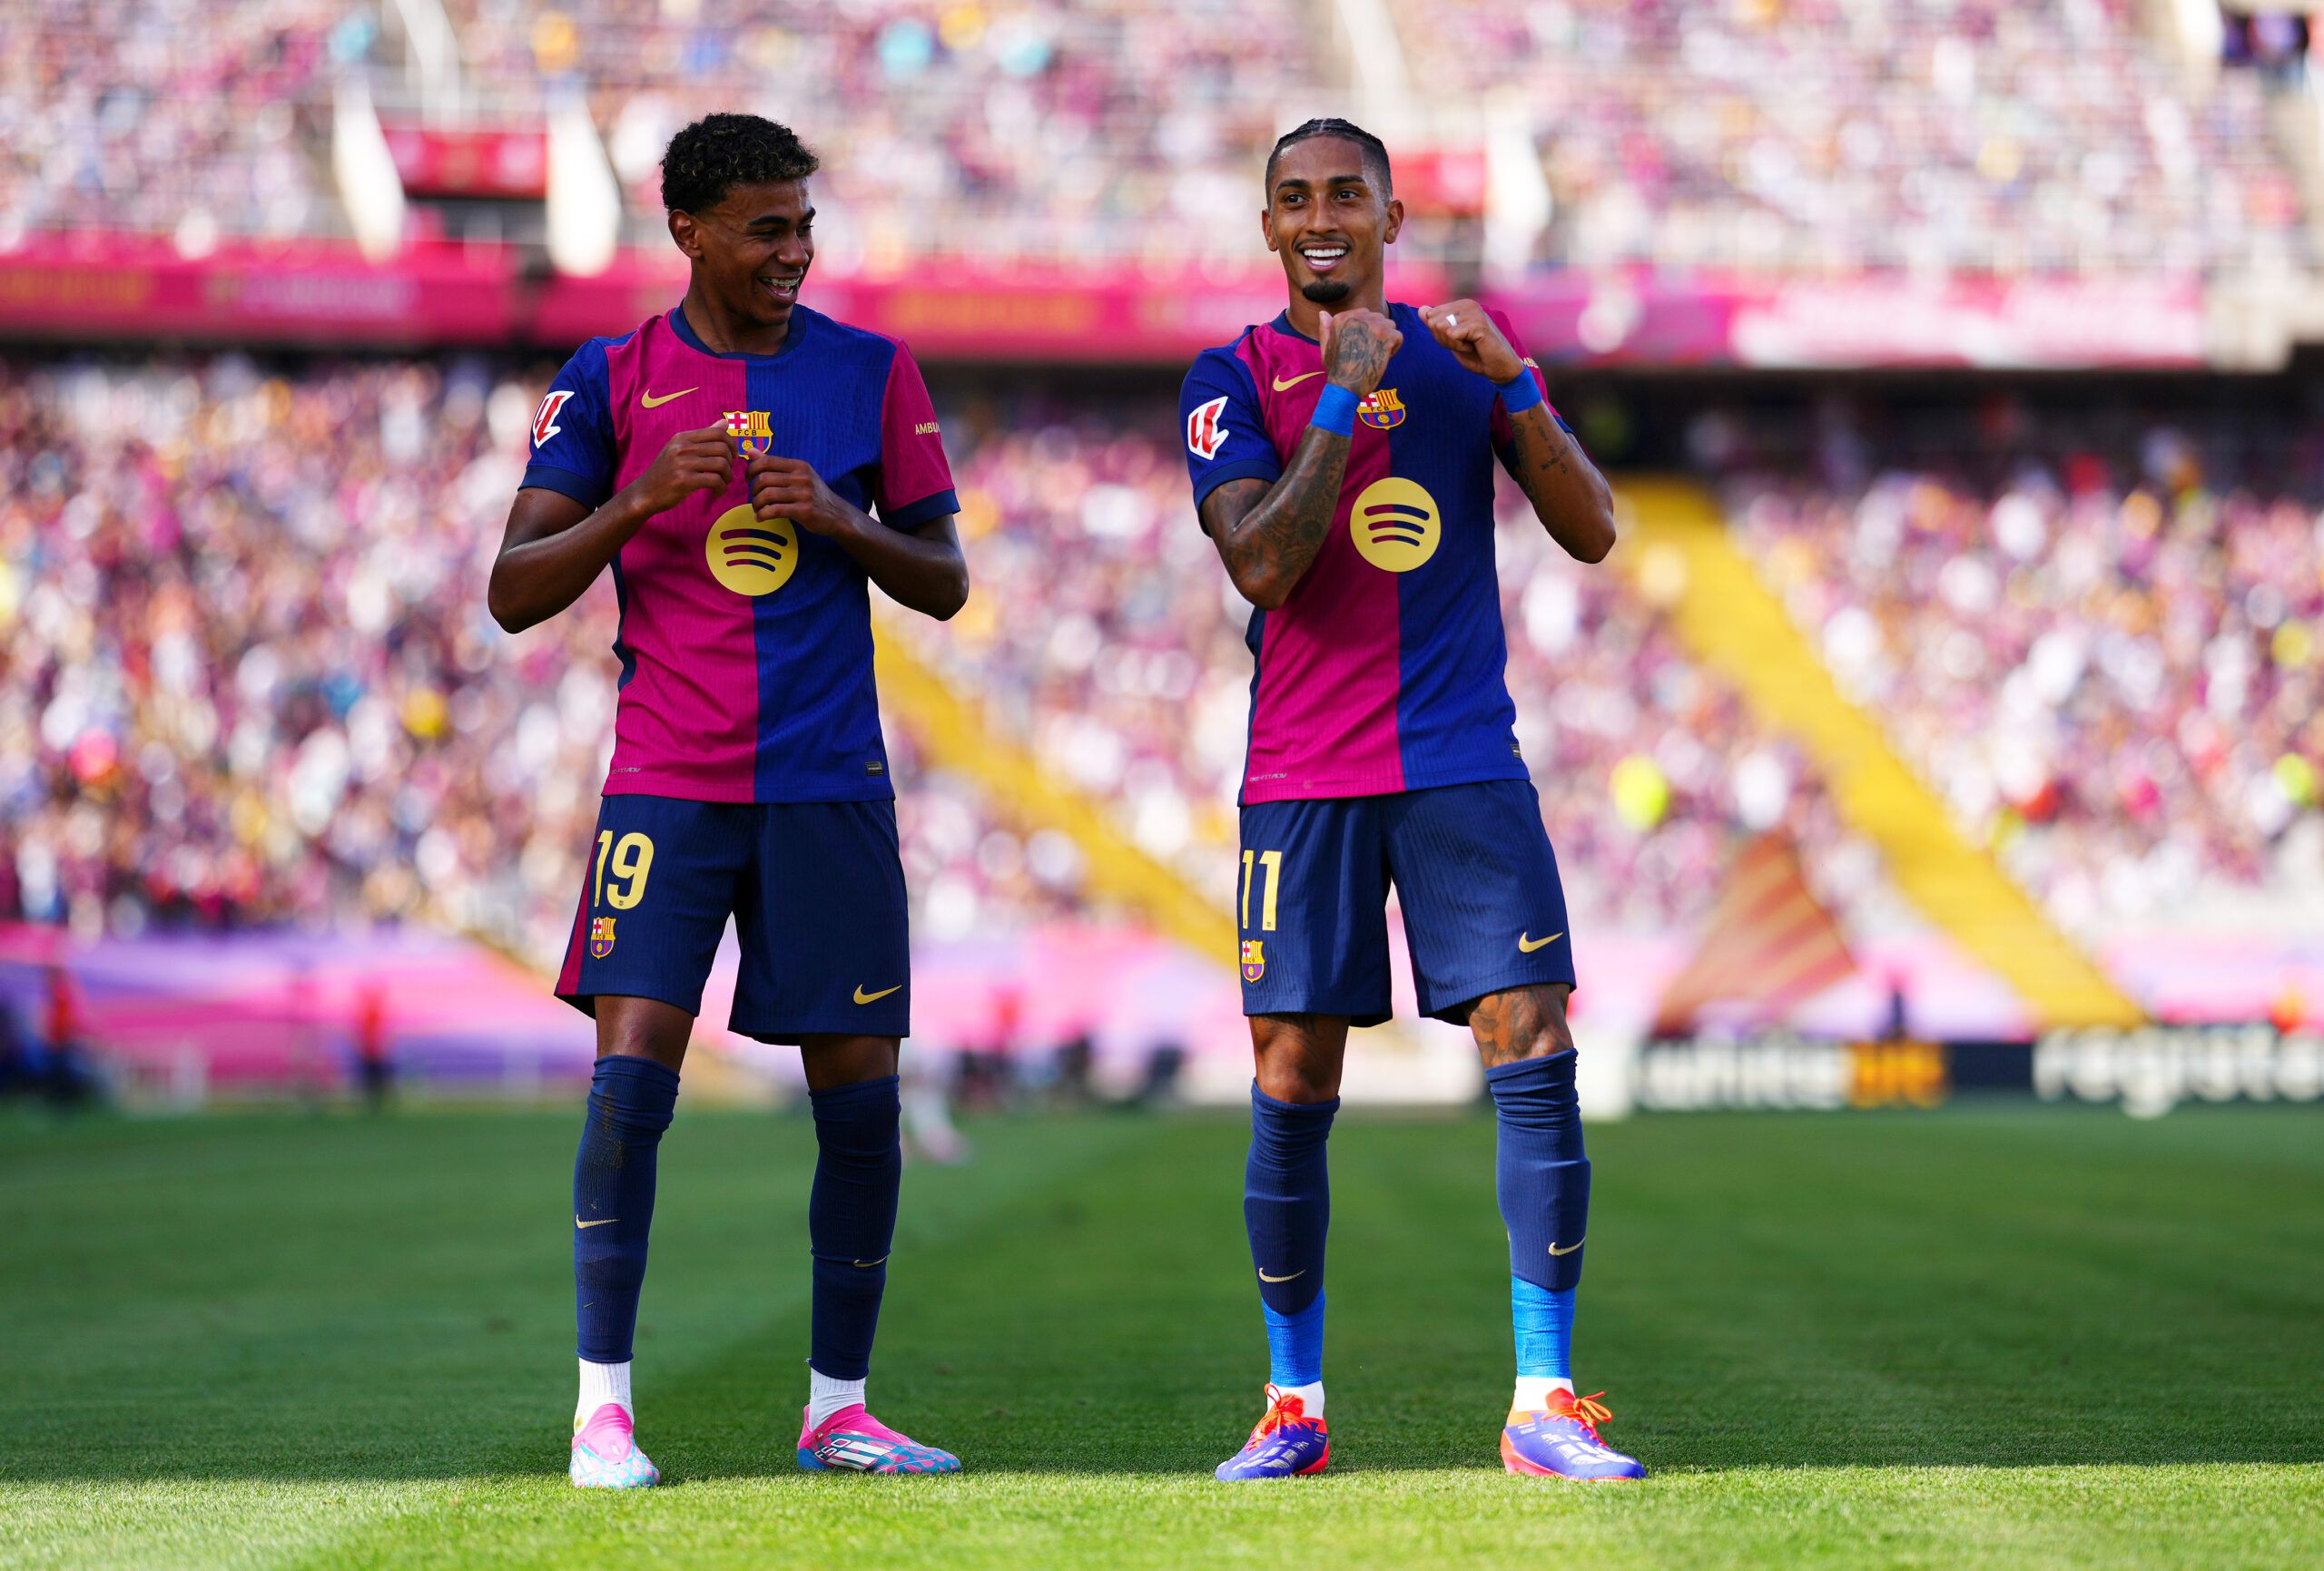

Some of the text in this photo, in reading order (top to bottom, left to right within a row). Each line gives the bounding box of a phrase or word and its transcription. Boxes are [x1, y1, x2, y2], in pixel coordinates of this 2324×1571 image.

[594, 830, 655, 910] 19
[1241, 849, 1282, 931] 11
[814, 1438, 852, 1460] F50
